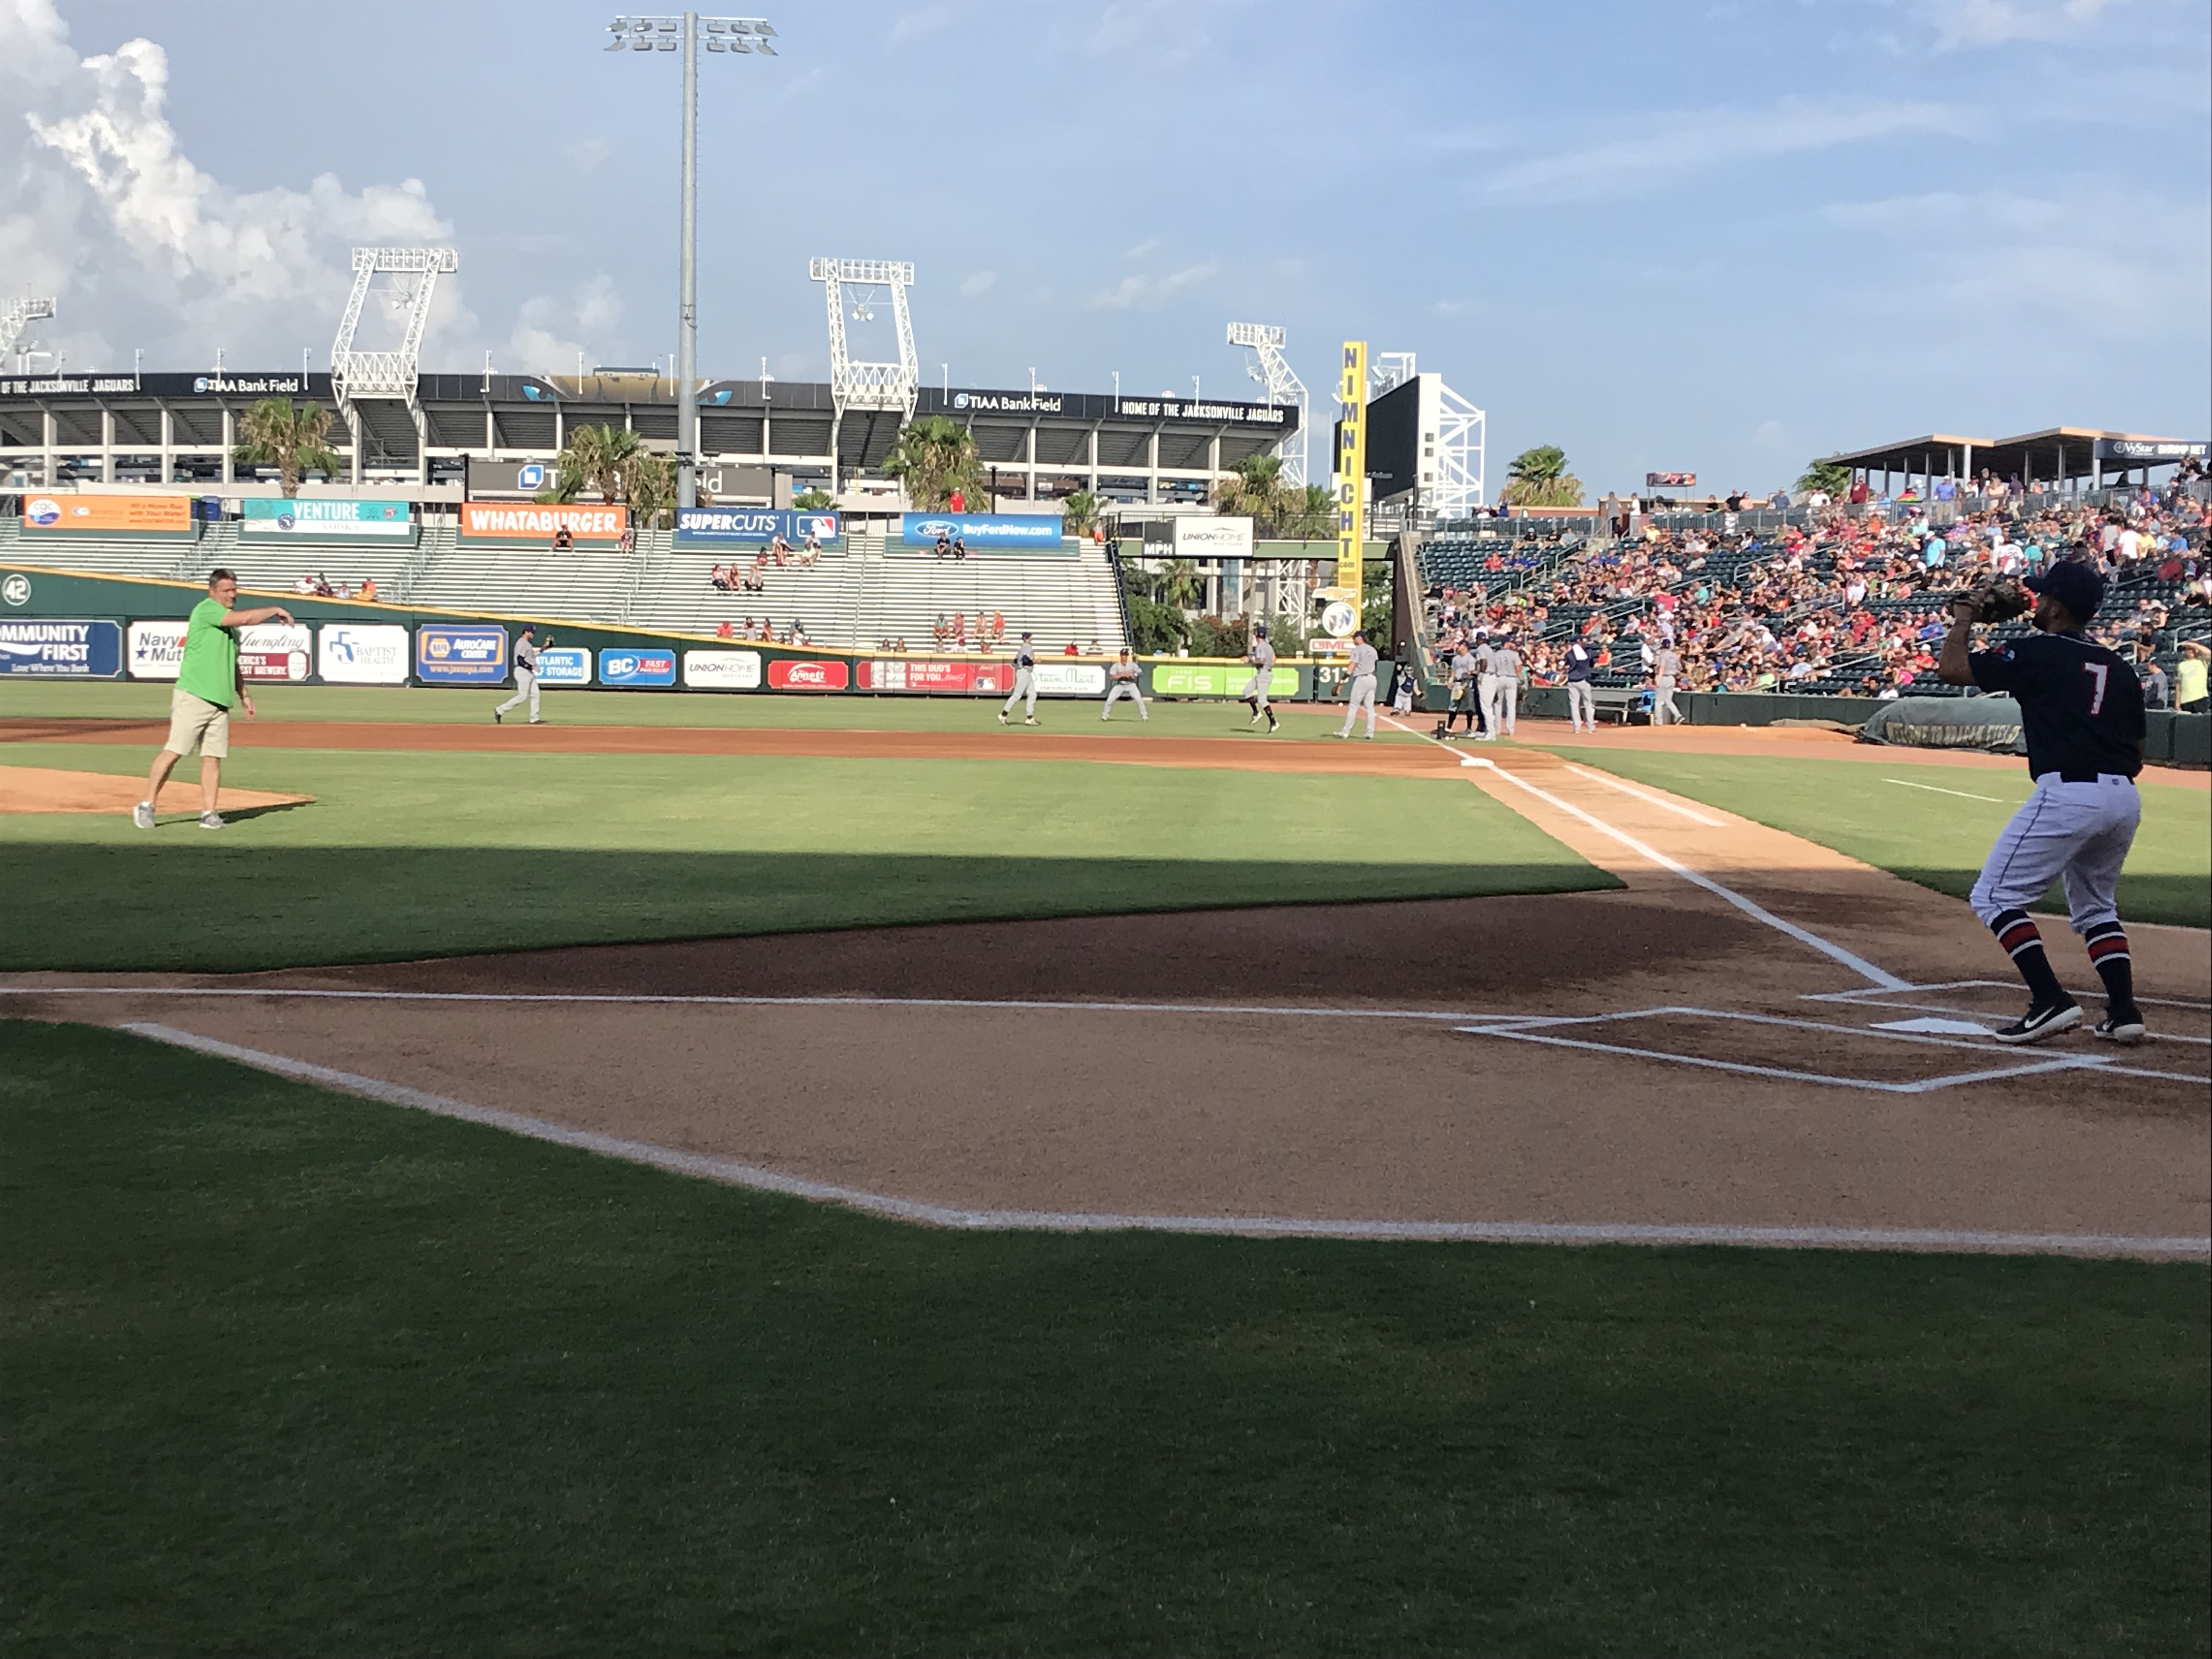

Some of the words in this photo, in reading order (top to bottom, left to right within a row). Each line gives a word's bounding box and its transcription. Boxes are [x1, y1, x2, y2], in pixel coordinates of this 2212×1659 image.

[13, 381, 27, 393] THE
[30, 380, 89, 393] JACKSONVILLE
[92, 379, 134, 392] JAGUARS
[208, 380, 236, 392] TIAA
[239, 379, 267, 392] Bank
[269, 378, 298, 392] Field
[969, 396, 999, 409] TIAA
[1001, 396, 1030, 410] Bank
[1034, 398, 1061, 411] Field
[1122, 402, 1147, 415] HOME
[1149, 403, 1160, 415] OF
[1164, 403, 1180, 416] THE
[1182, 404, 1244, 420] JACKSONVILLE
[1246, 408, 1284, 423] JAGUARS
[1341, 348, 1358, 558] NIMNICHT
[2125, 442, 2154, 454] VyStar
[34, 503, 53, 514] cgc
[293, 502, 360, 520] VENTURE
[471, 510, 617, 533] WHATABURGER
[680, 514, 776, 531] SUPERCUTS
[923, 522, 950, 535] Ford
[963, 523, 1052, 536] BuyFordNow.com
[1144, 544, 1173, 555] MPH
[6, 581, 26, 599] 42
[139, 632, 178, 648] Navy
[1312, 641, 1353, 650] GMC
[42, 644, 89, 660] FIRST
[151, 648, 182, 661] Mut
[357, 647, 398, 656] BAPTIST
[238, 656, 267, 665] ERICA'S
[535, 656, 574, 665] ATLANTIC
[608, 658, 633, 674] BC
[546, 667, 583, 676] STORAGE
[928, 664, 951, 673] BUD'S
[1066, 668, 1097, 684] Mart
[2084, 662, 2109, 714] 7
